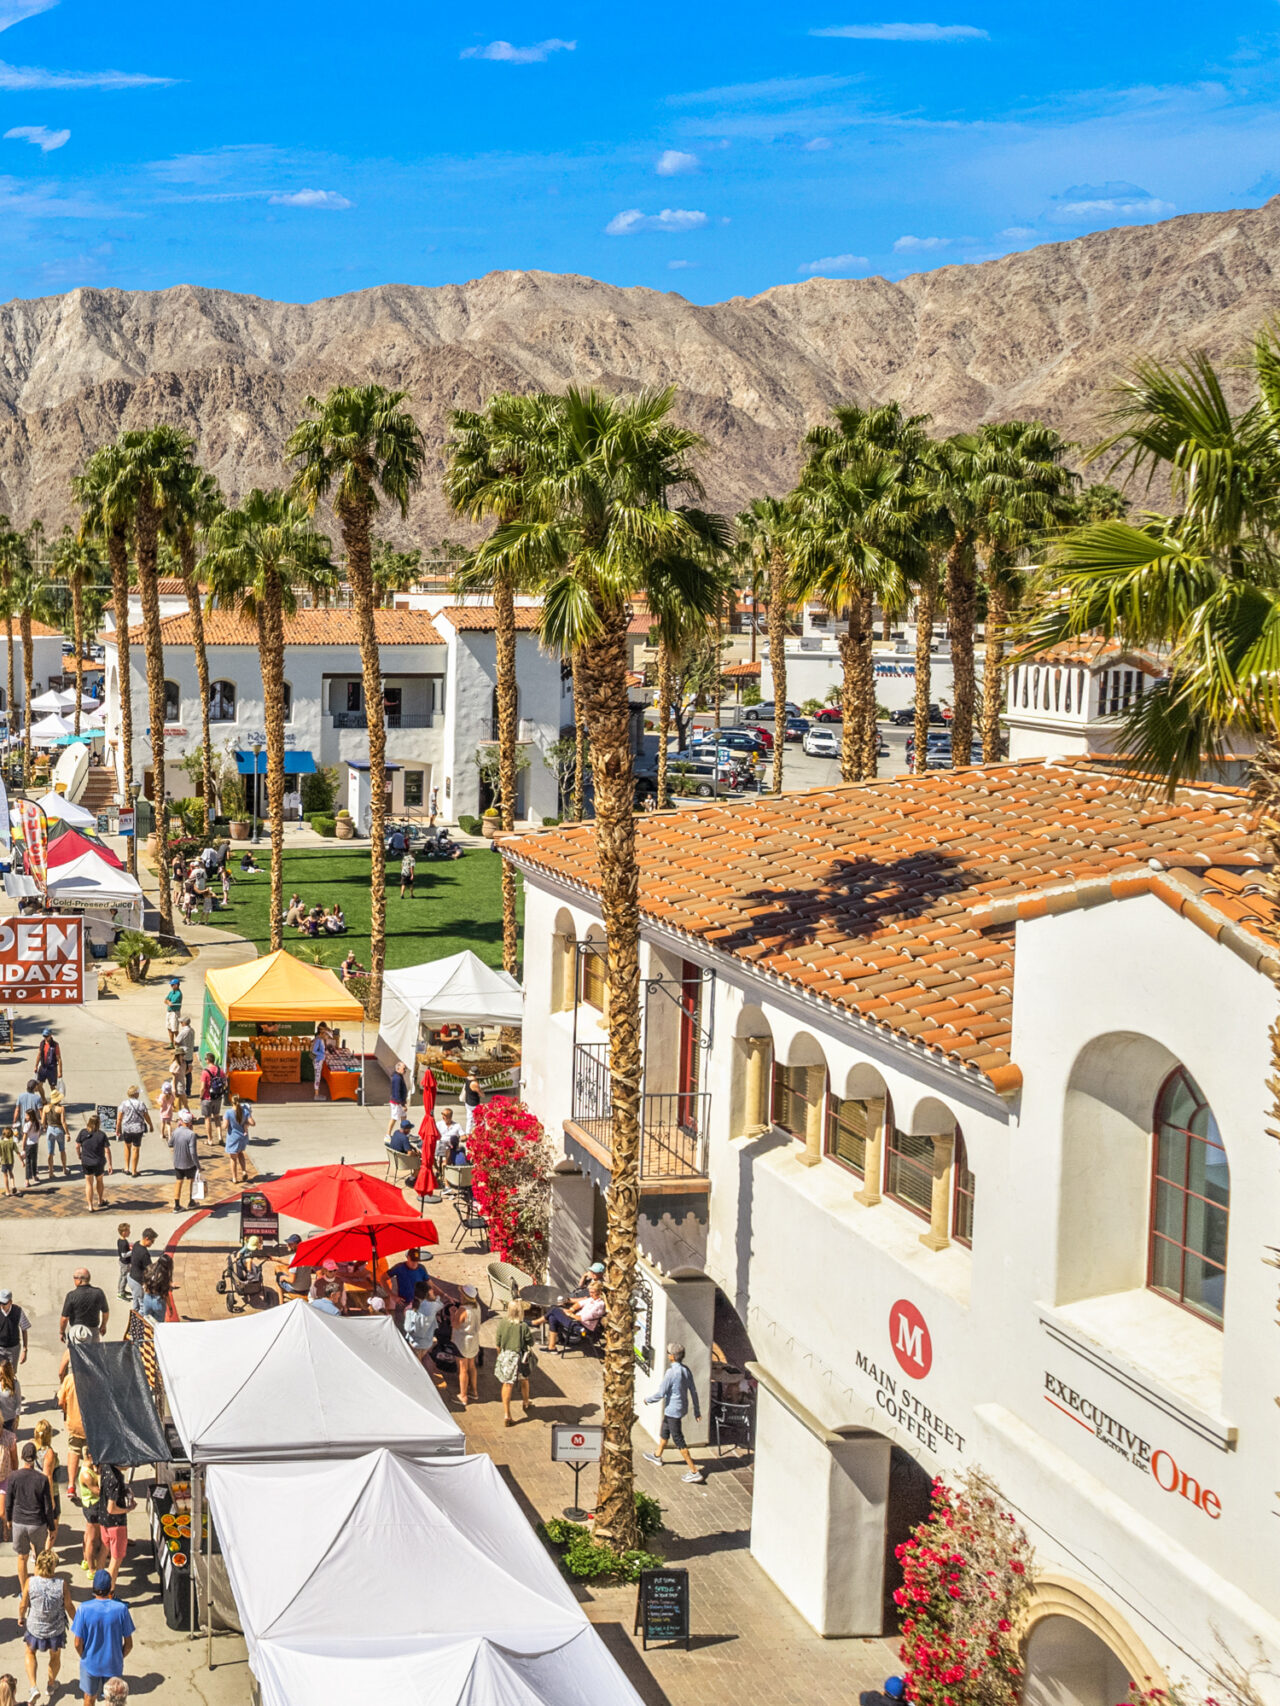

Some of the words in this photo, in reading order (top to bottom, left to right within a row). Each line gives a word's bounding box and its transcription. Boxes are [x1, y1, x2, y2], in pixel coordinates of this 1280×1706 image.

[27, 806, 42, 866] JUICE
[52, 898, 108, 908] Cold-Pressed
[110, 899, 133, 909] Juice
[2, 989, 27, 998] TO
[40, 988, 78, 999] 1PM
[896, 1312, 925, 1368] M
[855, 1350, 897, 1396] MAIN
[902, 1389, 966, 1454] STREET
[876, 1389, 938, 1454] COFFEE
[573, 1436, 583, 1445] M
[1044, 1370, 1152, 1463] EXECUTIVE
[1151, 1449, 1222, 1520] One
[1096, 1427, 1130, 1462] Escrow,
[1132, 1453, 1151, 1475] Inc.
